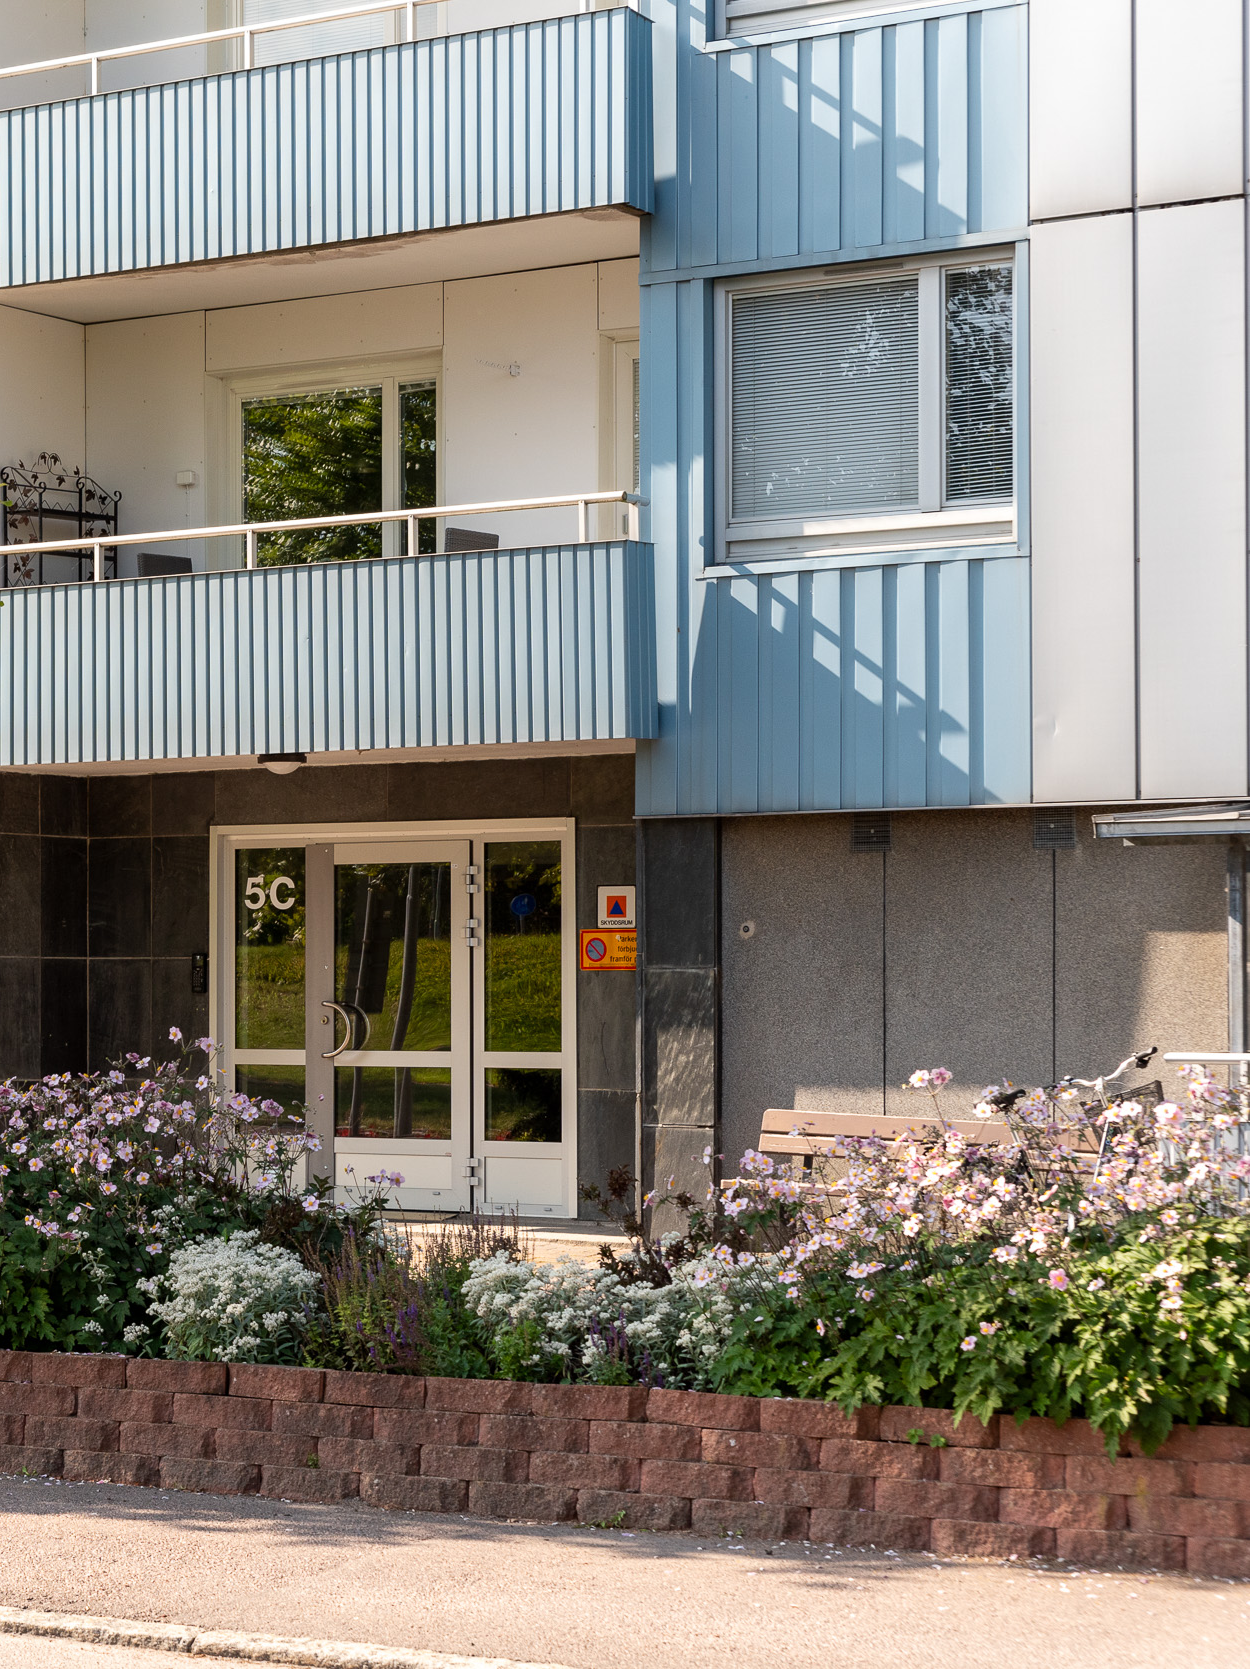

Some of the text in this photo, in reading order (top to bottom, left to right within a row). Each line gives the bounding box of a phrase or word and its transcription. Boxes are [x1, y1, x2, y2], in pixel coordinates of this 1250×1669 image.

[244, 876, 296, 910] 5C
[618, 945, 637, 954] förbju
[610, 955, 632, 963] framför
